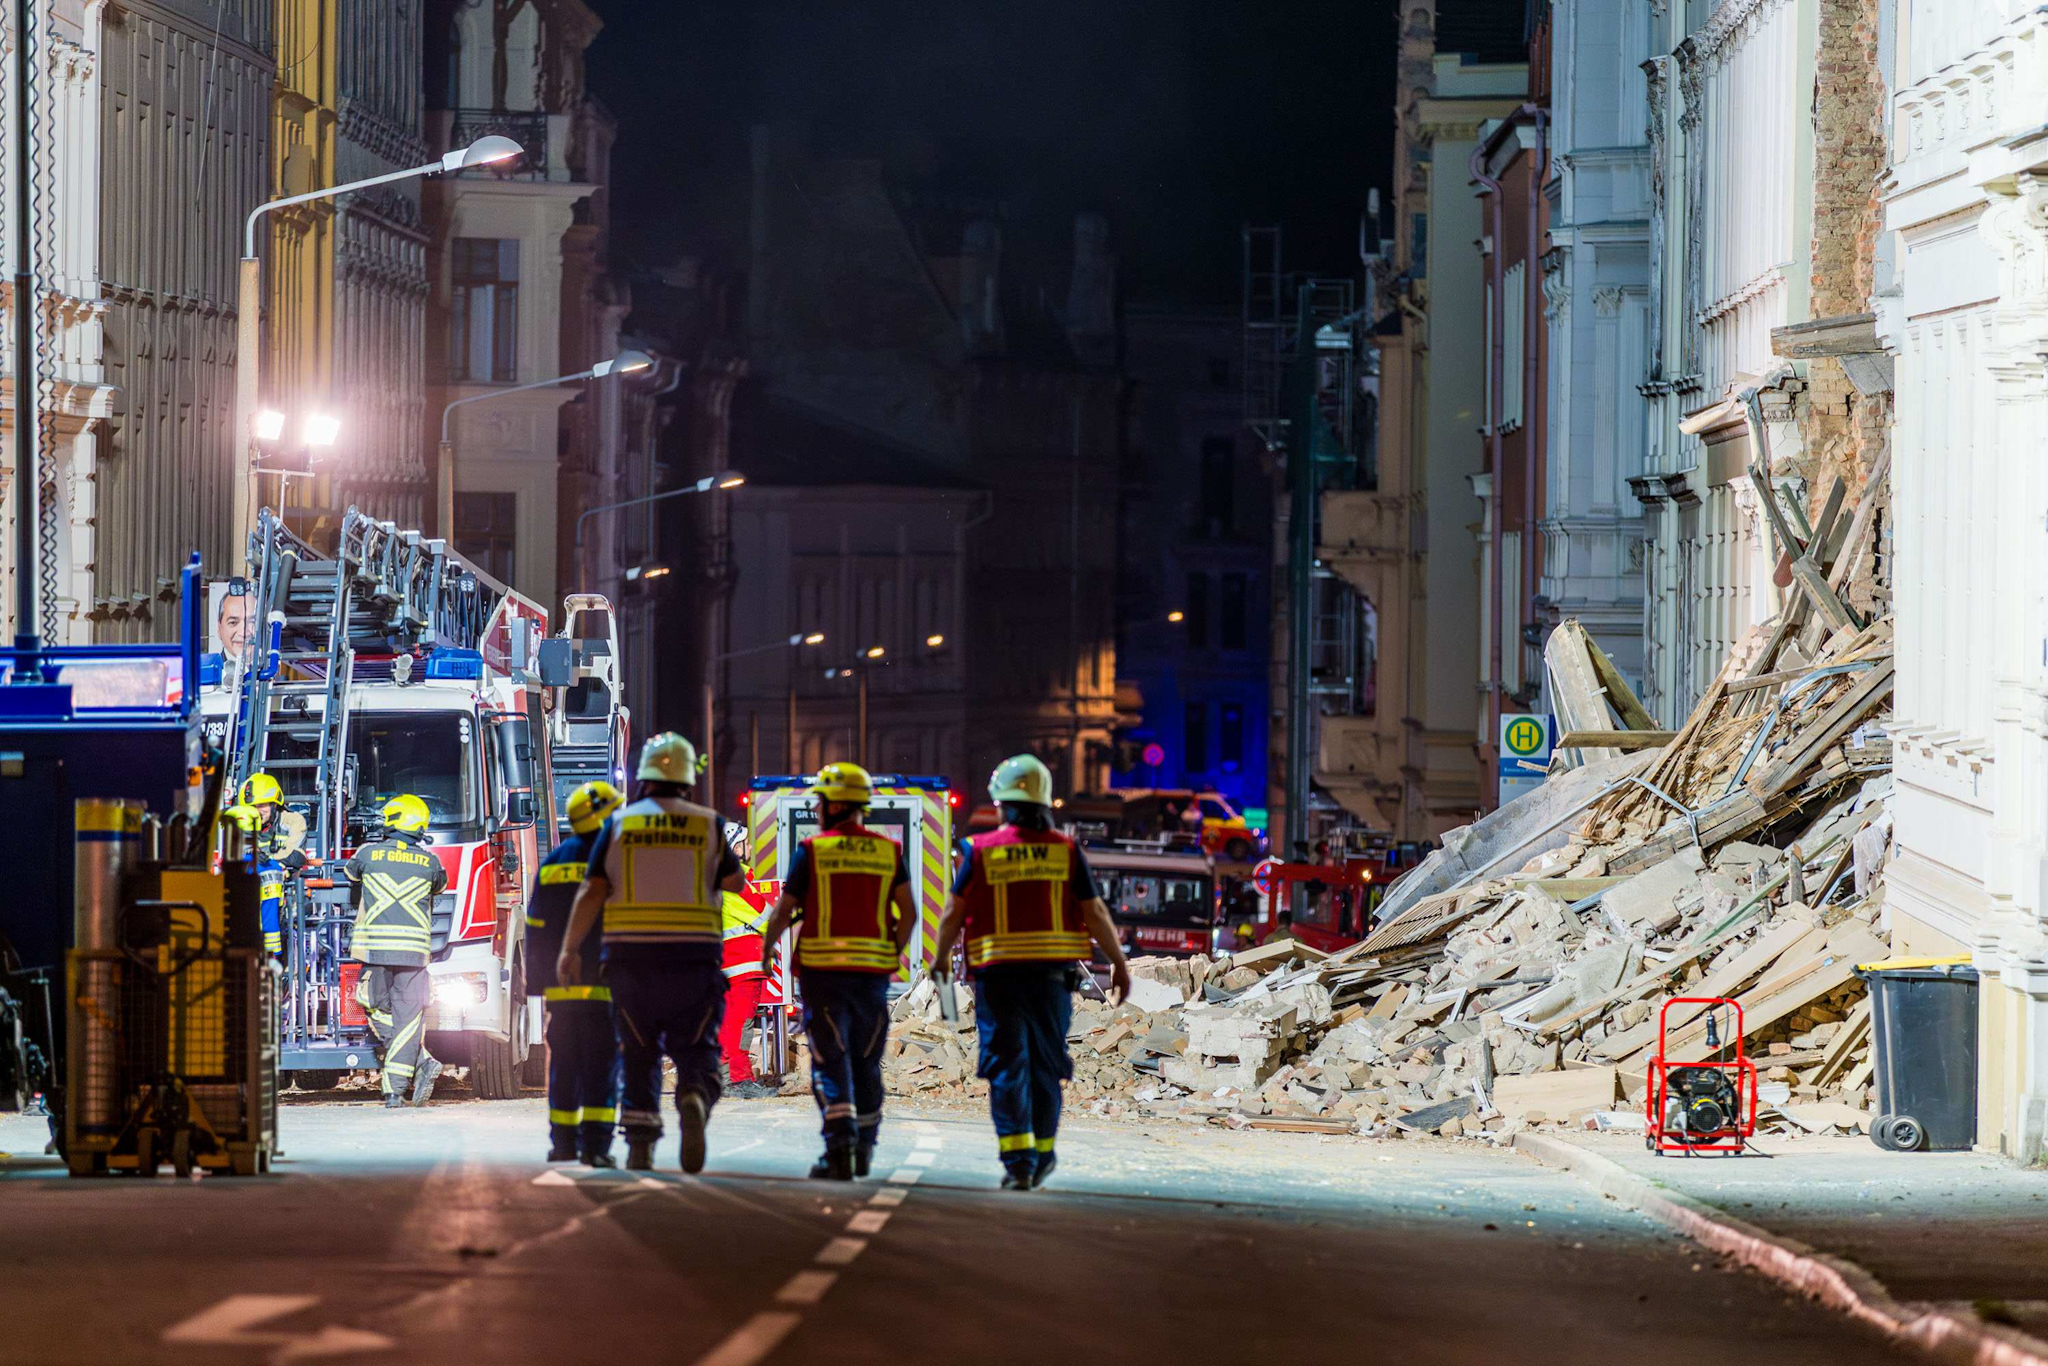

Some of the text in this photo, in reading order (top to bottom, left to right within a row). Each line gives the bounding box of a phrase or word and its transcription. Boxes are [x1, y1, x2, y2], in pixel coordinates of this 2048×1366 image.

[1516, 726, 1532, 747] H
[644, 815, 688, 828] THW
[795, 809, 809, 819] GR
[623, 831, 704, 846] Zugführer
[371, 848, 429, 867] BF GÖRLITZ
[1005, 846, 1048, 861] THW
